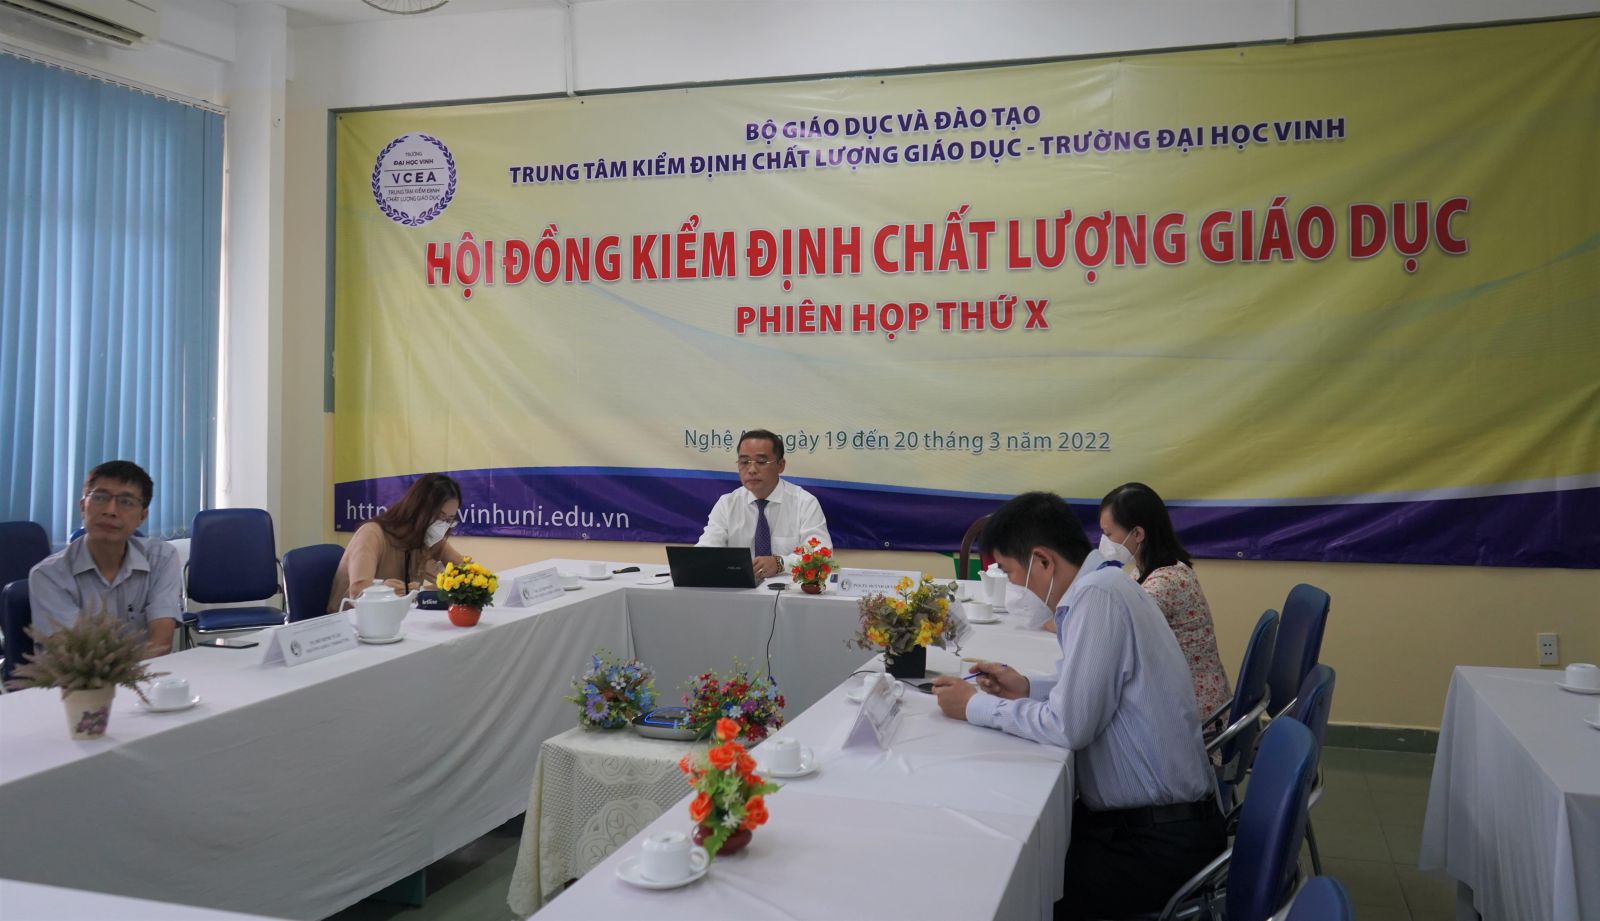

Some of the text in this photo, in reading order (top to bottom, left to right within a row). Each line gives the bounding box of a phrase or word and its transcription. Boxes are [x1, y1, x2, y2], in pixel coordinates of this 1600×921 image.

[746, 105, 1041, 144] BỘ GIÁO DỤC VÀ ĐÀO TẠO
[509, 163, 580, 184] TRUNG
[583, 158, 628, 180] TÂM
[632, 152, 686, 177] KIỂM
[690, 154, 748, 178] ĐỊNH
[751, 145, 811, 171] CHẤT
[814, 145, 898, 173] LƯỢNG
[903, 138, 965, 163] GIÁO
[970, 138, 1022, 164] DỤC
[1040, 129, 1151, 155] TRƯỜNG
[1156, 127, 1204, 153] ĐẠI
[1211, 122, 1269, 150] HỌC
[1273, 118, 1346, 142] VINH
[426, 196, 1470, 298] HỘI ĐỒNG KIỂM ĐỊNH CHẤT LƯỢNG GIÁO DỤC
[736, 294, 1049, 341] PHIÊN HỌP THỨ X
[685, 429, 733, 450] Nghệ
[778, 430, 820, 452] gày
[824, 431, 848, 449] 19
[852, 429, 890, 449] đến
[895, 430, 919, 449] 20
[923, 430, 984, 454] tháng
[989, 431, 1001, 449] 3
[1006, 431, 1052, 450] năm
[1058, 431, 1112, 450] 2022
